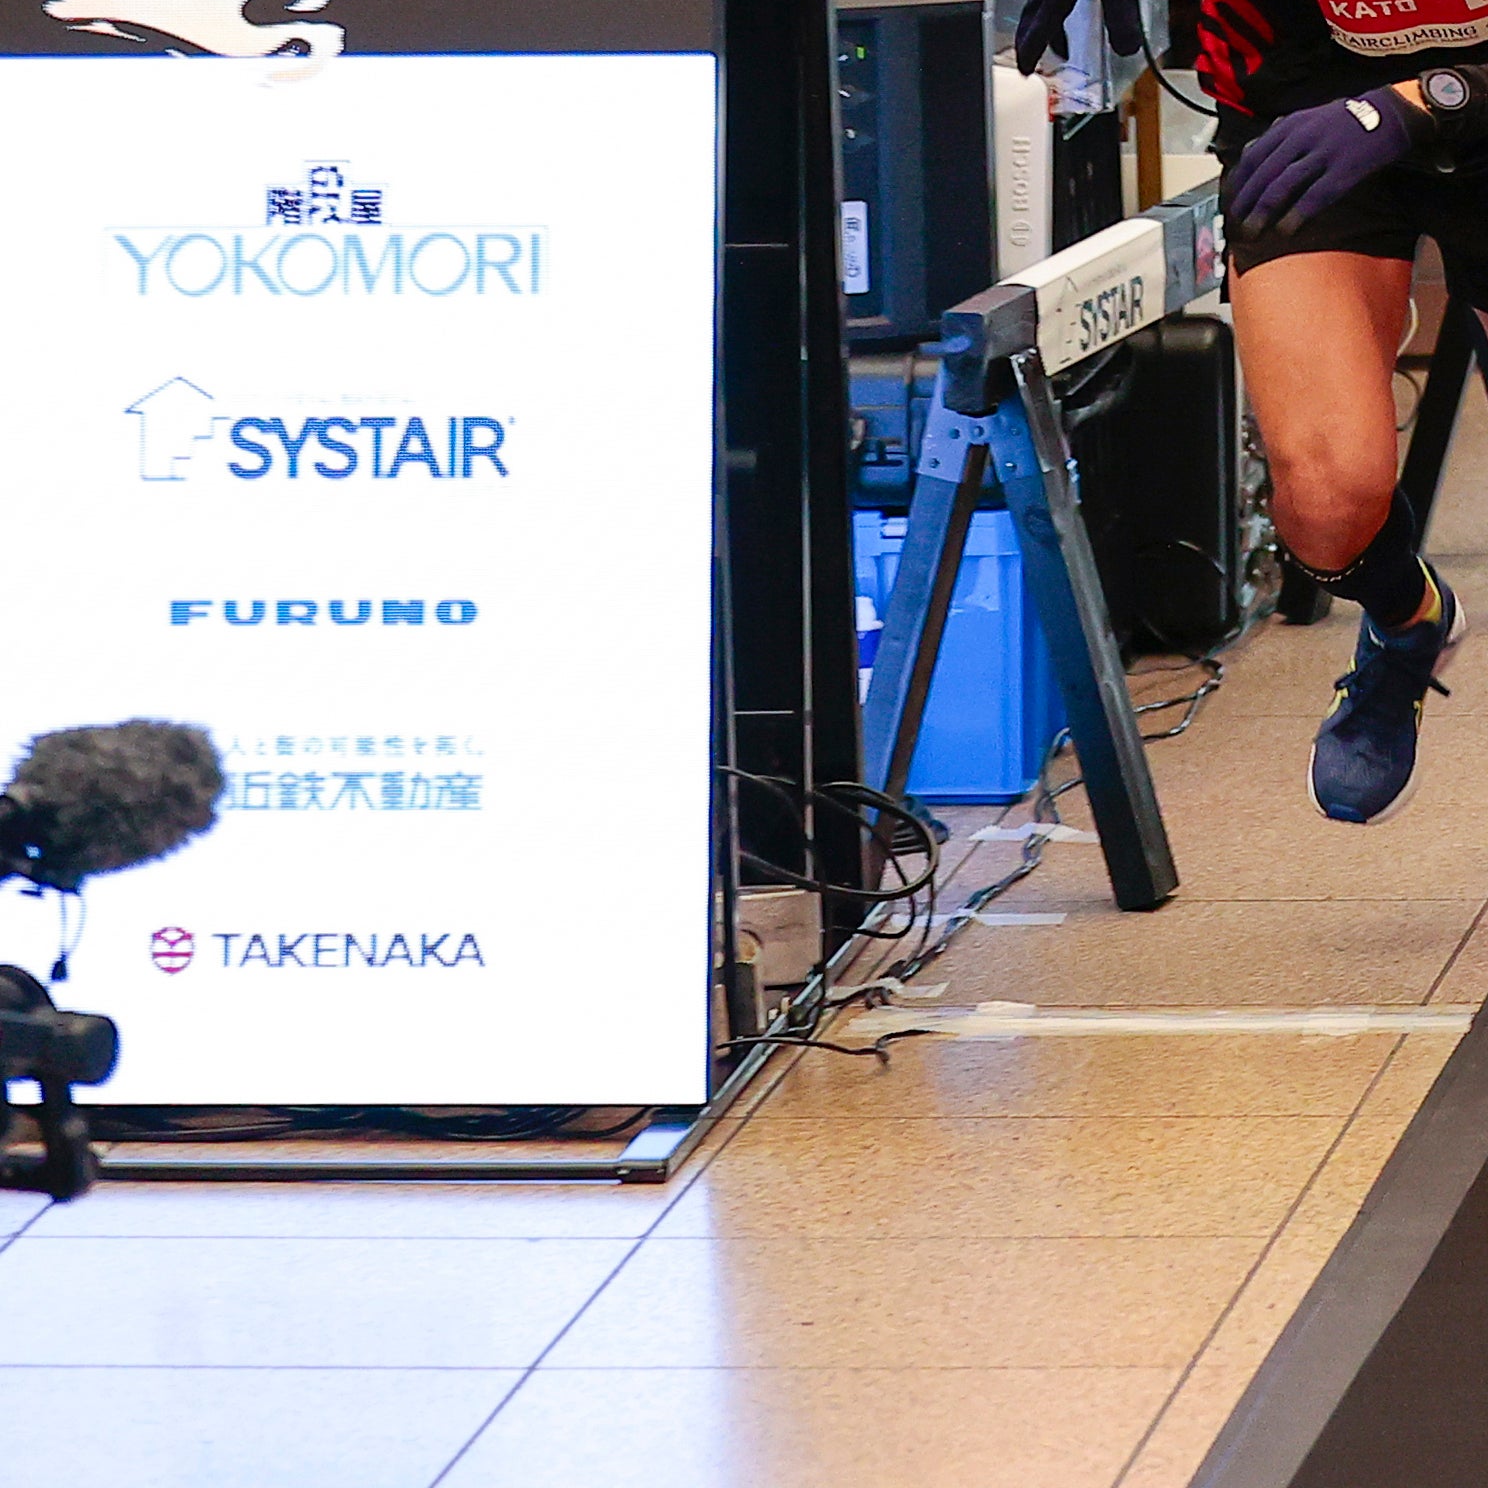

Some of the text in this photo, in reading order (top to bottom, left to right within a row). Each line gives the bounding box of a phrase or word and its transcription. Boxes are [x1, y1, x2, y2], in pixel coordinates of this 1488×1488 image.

[113, 232, 542, 298] YOKOMORI
[227, 415, 510, 480] SYSTAIR
[169, 599, 479, 626] FURUNO
[211, 932, 486, 968] TAKENAKA
